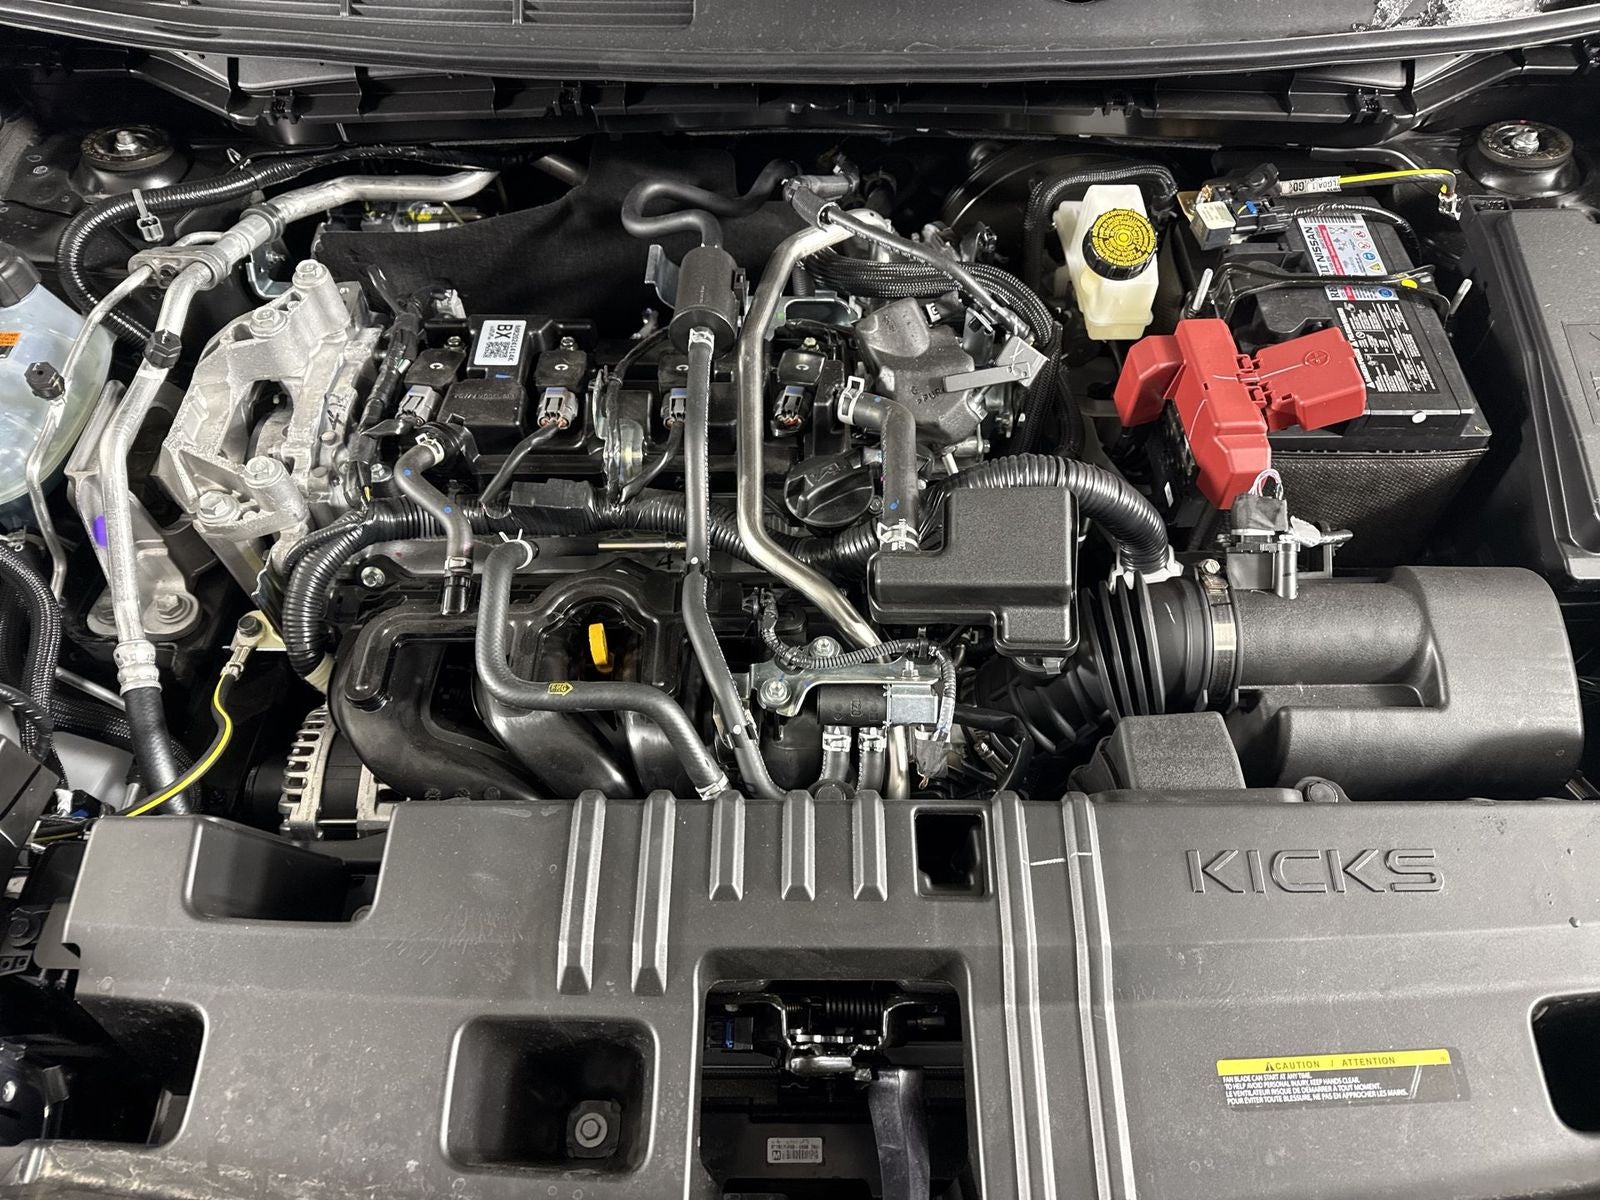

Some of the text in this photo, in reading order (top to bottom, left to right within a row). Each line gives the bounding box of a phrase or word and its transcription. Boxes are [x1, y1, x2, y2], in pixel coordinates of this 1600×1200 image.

[1304, 226, 1324, 263] NISSAN
[495, 325, 513, 339] BX
[1187, 849, 1445, 894] KICKS
[1275, 1061, 1320, 1070] CAUTION
[1342, 1057, 1396, 1066] ATTENTION
[1233, 1089, 1270, 1097] VENTILATEUR
